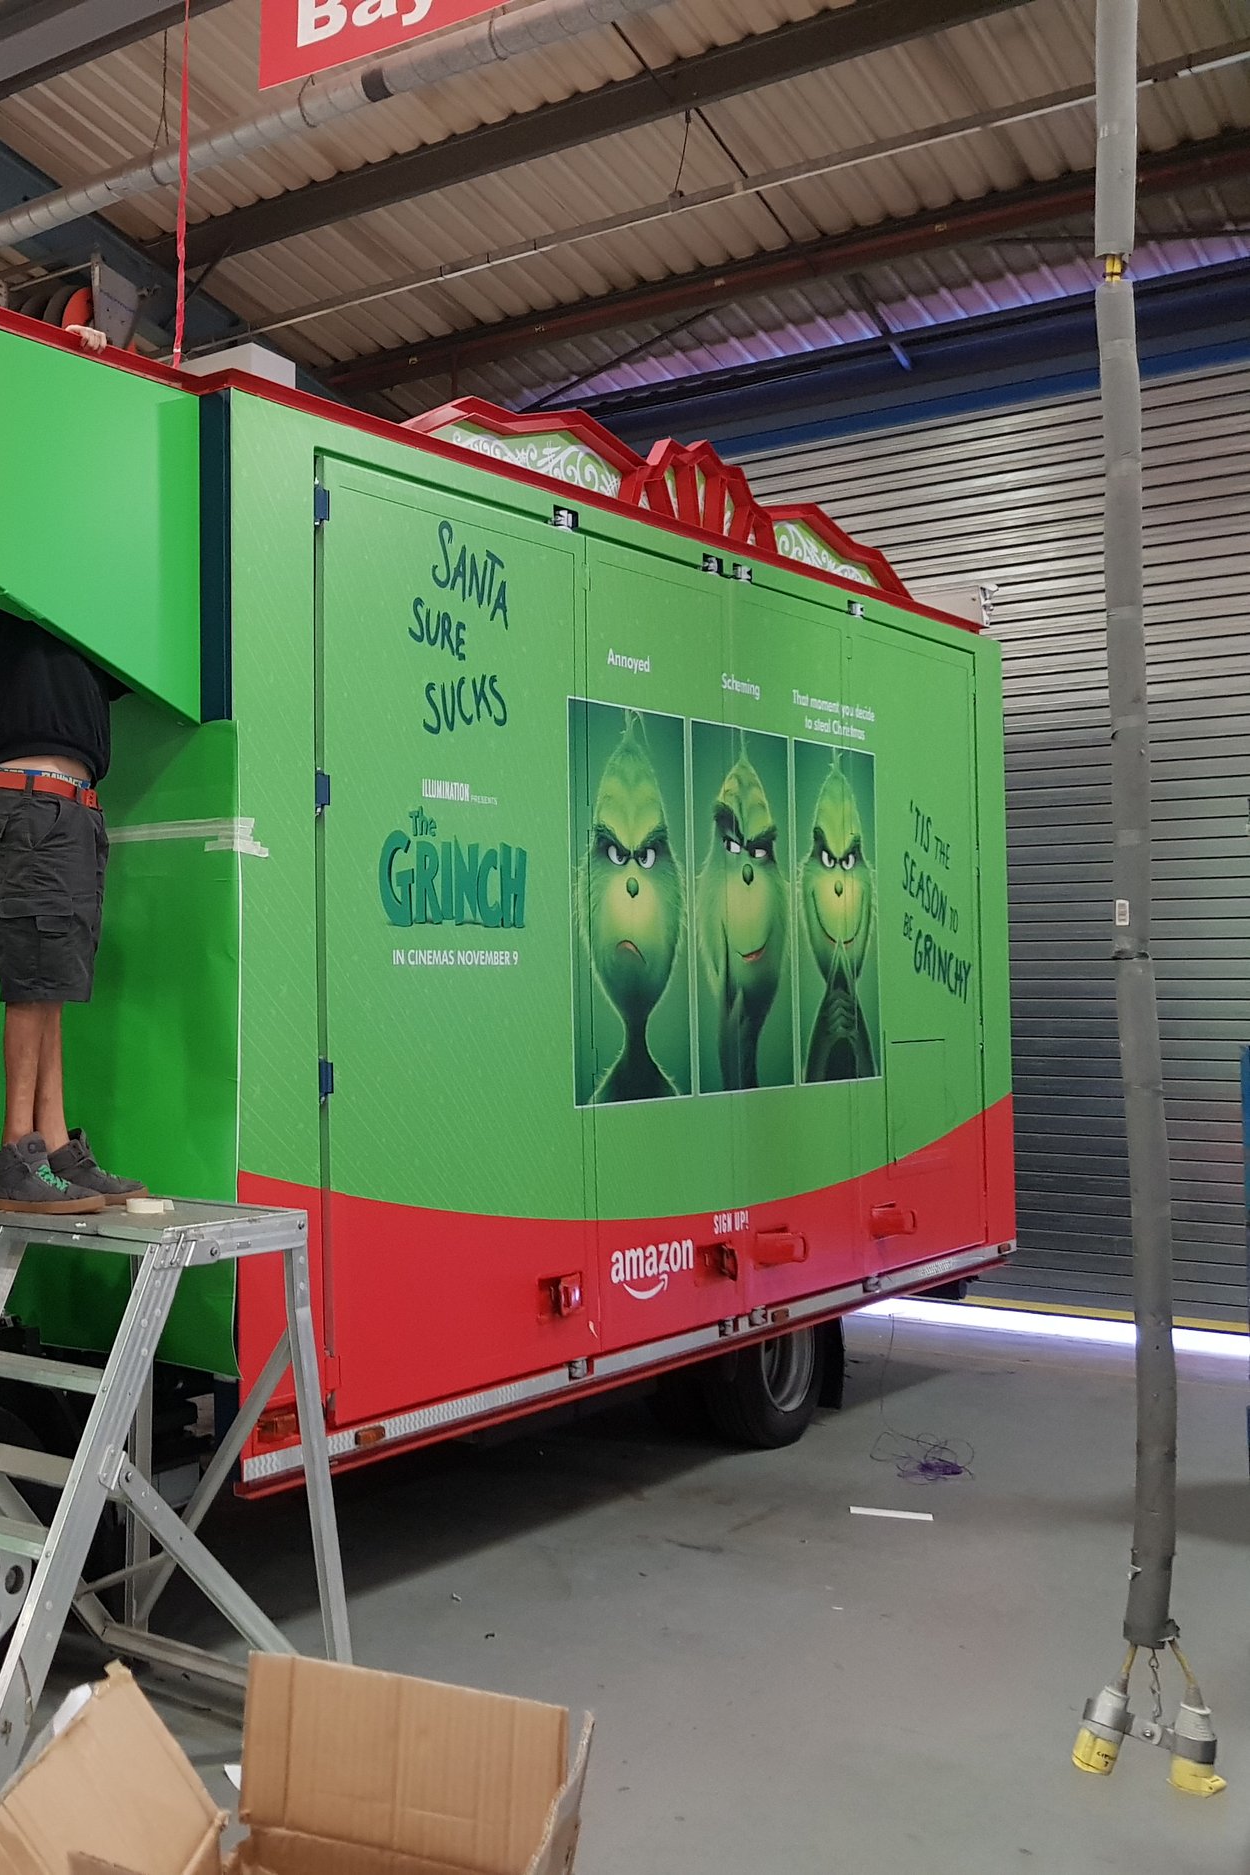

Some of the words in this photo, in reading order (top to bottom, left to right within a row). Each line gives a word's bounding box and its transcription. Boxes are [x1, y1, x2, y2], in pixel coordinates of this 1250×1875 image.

[431, 520, 509, 630] SANTA
[408, 597, 466, 661] SURE
[607, 648, 651, 674] Annoyed
[721, 672, 761, 700] Scheming
[423, 674, 508, 735] SUCKS
[792, 689, 809, 706] That
[810, 697, 839, 713] moment
[841, 705, 855, 719] you
[855, 704, 875, 722] decide
[804, 715, 813, 730] to
[813, 718, 831, 733] steal
[832, 720, 865, 740] Christmas
[422, 778, 470, 802] ILLUMINATION
[408, 806, 437, 837] The
[933, 834, 951, 870] THE
[378, 829, 528, 928] GRINCH
[902, 851, 948, 927] SEASON
[948, 905, 959, 934] TO
[392, 949, 405, 966] IN
[407, 949, 455, 966] CINEMAS
[457, 949, 511, 966] NOVEMBER
[512, 950, 519, 966] 9
[902, 911, 914, 941] BE
[913, 929, 972, 1005] GRINCHY
[713, 1212, 733, 1235] SIGN
[734, 1210, 749, 1232] UP!
[610, 1238, 695, 1285] amazon
